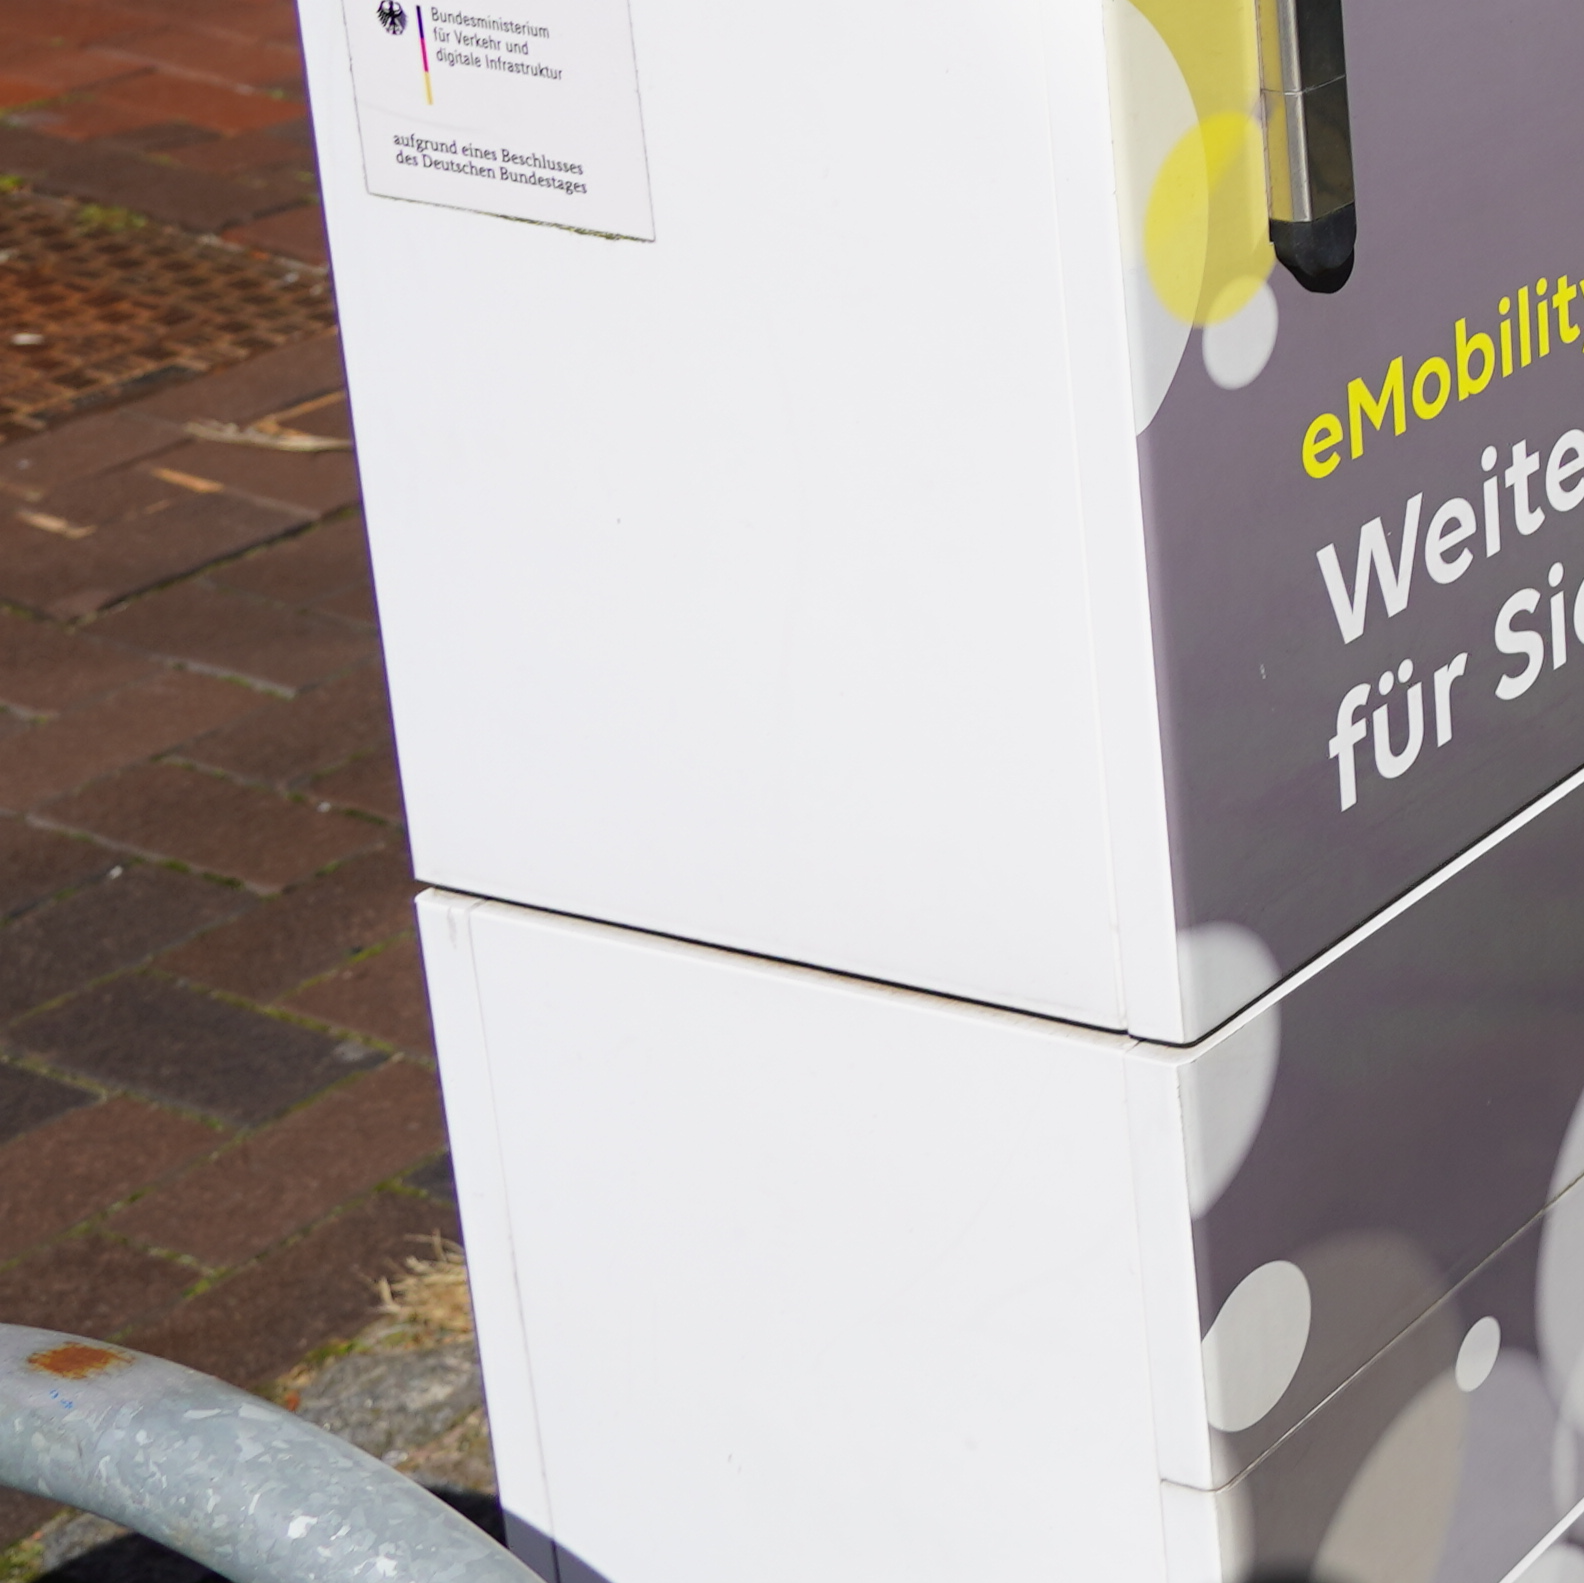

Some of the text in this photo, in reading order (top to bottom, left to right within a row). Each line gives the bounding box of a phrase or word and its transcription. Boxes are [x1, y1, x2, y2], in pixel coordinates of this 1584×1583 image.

[430, 6, 549, 38] Bundesministerium
[432, 26, 529, 55] für Verkehr und
[435, 47, 562, 80] digitale Infrastruktur
[393, 132, 583, 175] aufgrund eines Beschlusses
[395, 149, 587, 195] des Deutschen Bundestages
[1327, 653, 1470, 813] für
